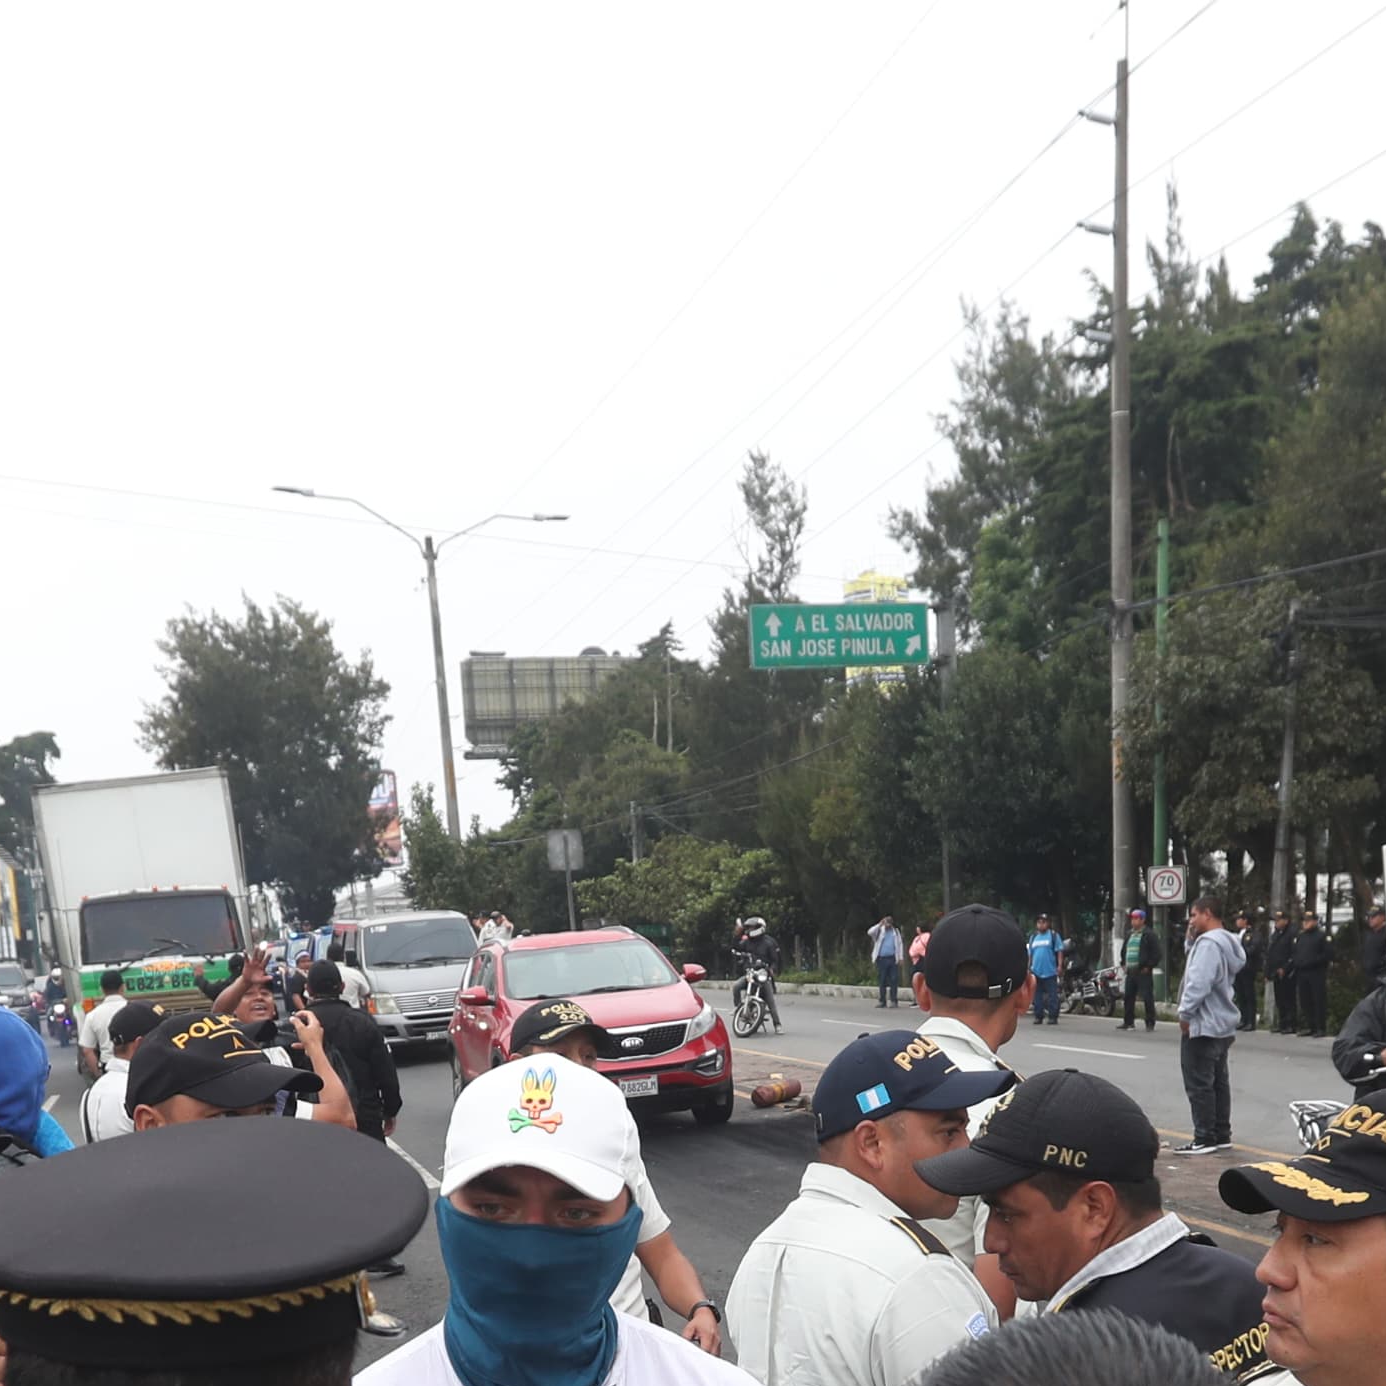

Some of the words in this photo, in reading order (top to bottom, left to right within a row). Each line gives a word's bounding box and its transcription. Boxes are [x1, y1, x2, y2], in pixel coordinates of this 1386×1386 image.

[795, 614, 806, 633] A
[812, 614, 829, 633] EL
[835, 612, 915, 632] SALVADOR
[759, 639, 792, 658] SAN
[797, 638, 837, 657] JOSE
[841, 636, 896, 656] PINULA
[1158, 875, 1175, 887] 70
[1042, 1143, 1088, 1168] PNC
